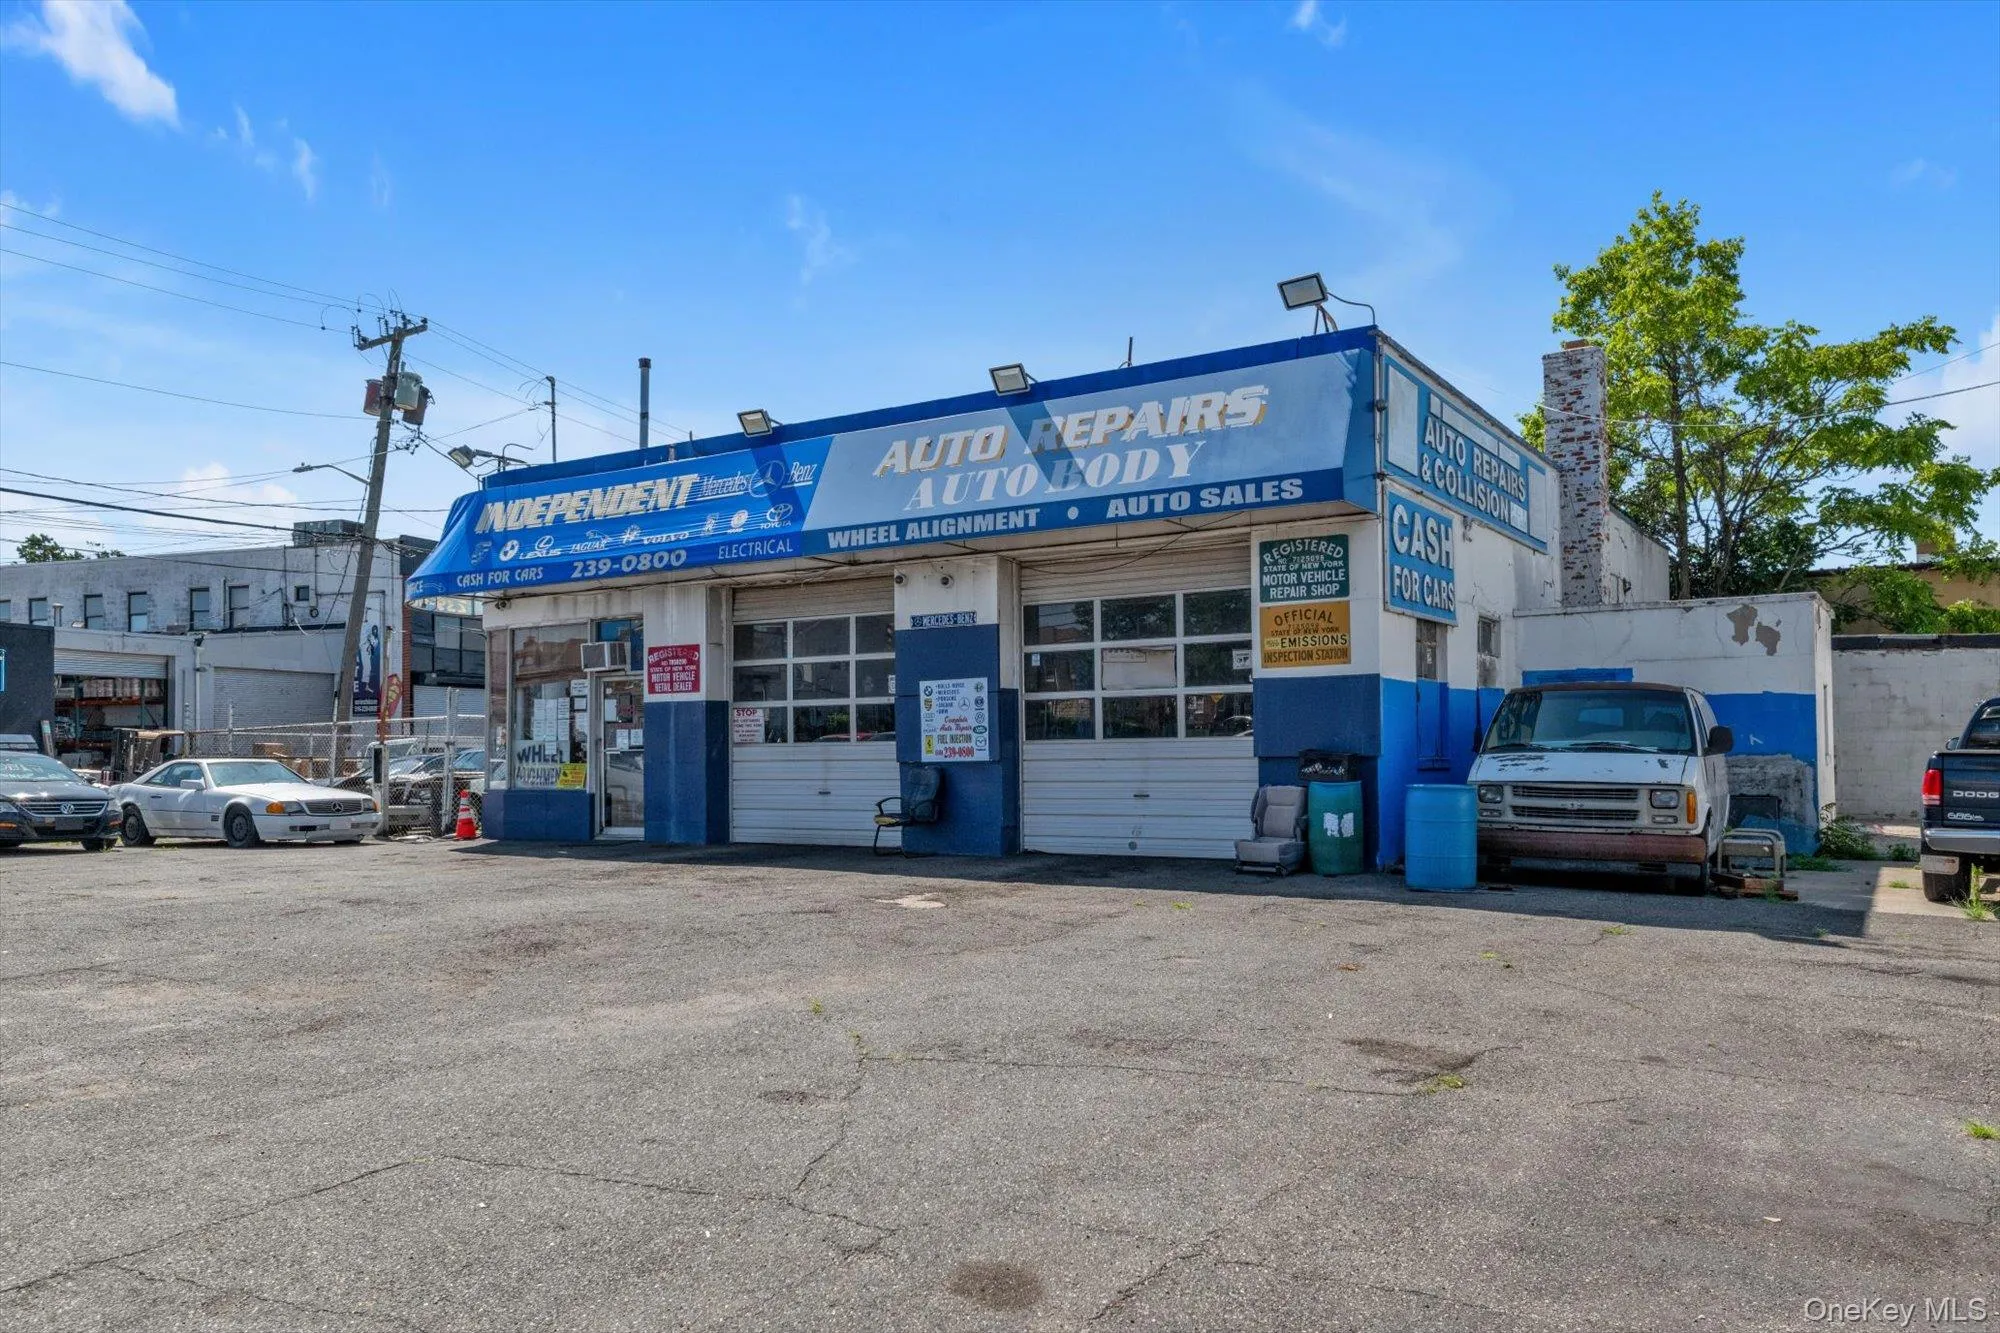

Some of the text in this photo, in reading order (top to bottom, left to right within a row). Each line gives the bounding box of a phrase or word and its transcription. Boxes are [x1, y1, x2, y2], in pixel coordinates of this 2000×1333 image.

[872, 384, 1269, 478] AUTO REPAIRS
[1424, 415, 1526, 502] AUTO REPAIRS
[702, 461, 818, 497] Mercedes Benz
[1421, 453, 1511, 523] & COLLISION
[474, 473, 699, 534] INDEPENDENT
[1106, 478, 1303, 519] AUTO SALES
[760, 520, 792, 530] TOYOTA
[827, 508, 1041, 550] WHEEL ALIGNMENT
[643, 531, 690, 545] VOLVO
[1392, 504, 1453, 571] CASH
[519, 548, 563, 560] LEXUS
[570, 541, 607, 554] JAGUAR
[718, 539, 794, 560] ELECTRICAL
[1263, 539, 1344, 565] REGISTERED
[571, 549, 687, 578] 239-0800
[1322, 560, 1344, 568] YORK
[457, 567, 543, 588] CASH FOR CARS
[1262, 569, 1346, 586] MOTOR VEHICLE
[1270, 583, 1340, 599] REPAIR SHOP
[1394, 564, 1454, 613] FOR CARS
[1274, 608, 1333, 626] OFFICIAL
[1281, 634, 1347, 648] EMISSIONS
[1264, 650, 1314, 663] INSPECTION
[1315, 647, 1348, 660] STATION
[651, 671, 695, 683] MOTOR VEHICLE
[655, 681, 692, 692] RETAIL DEALER
[736, 708, 758, 716] STOP
